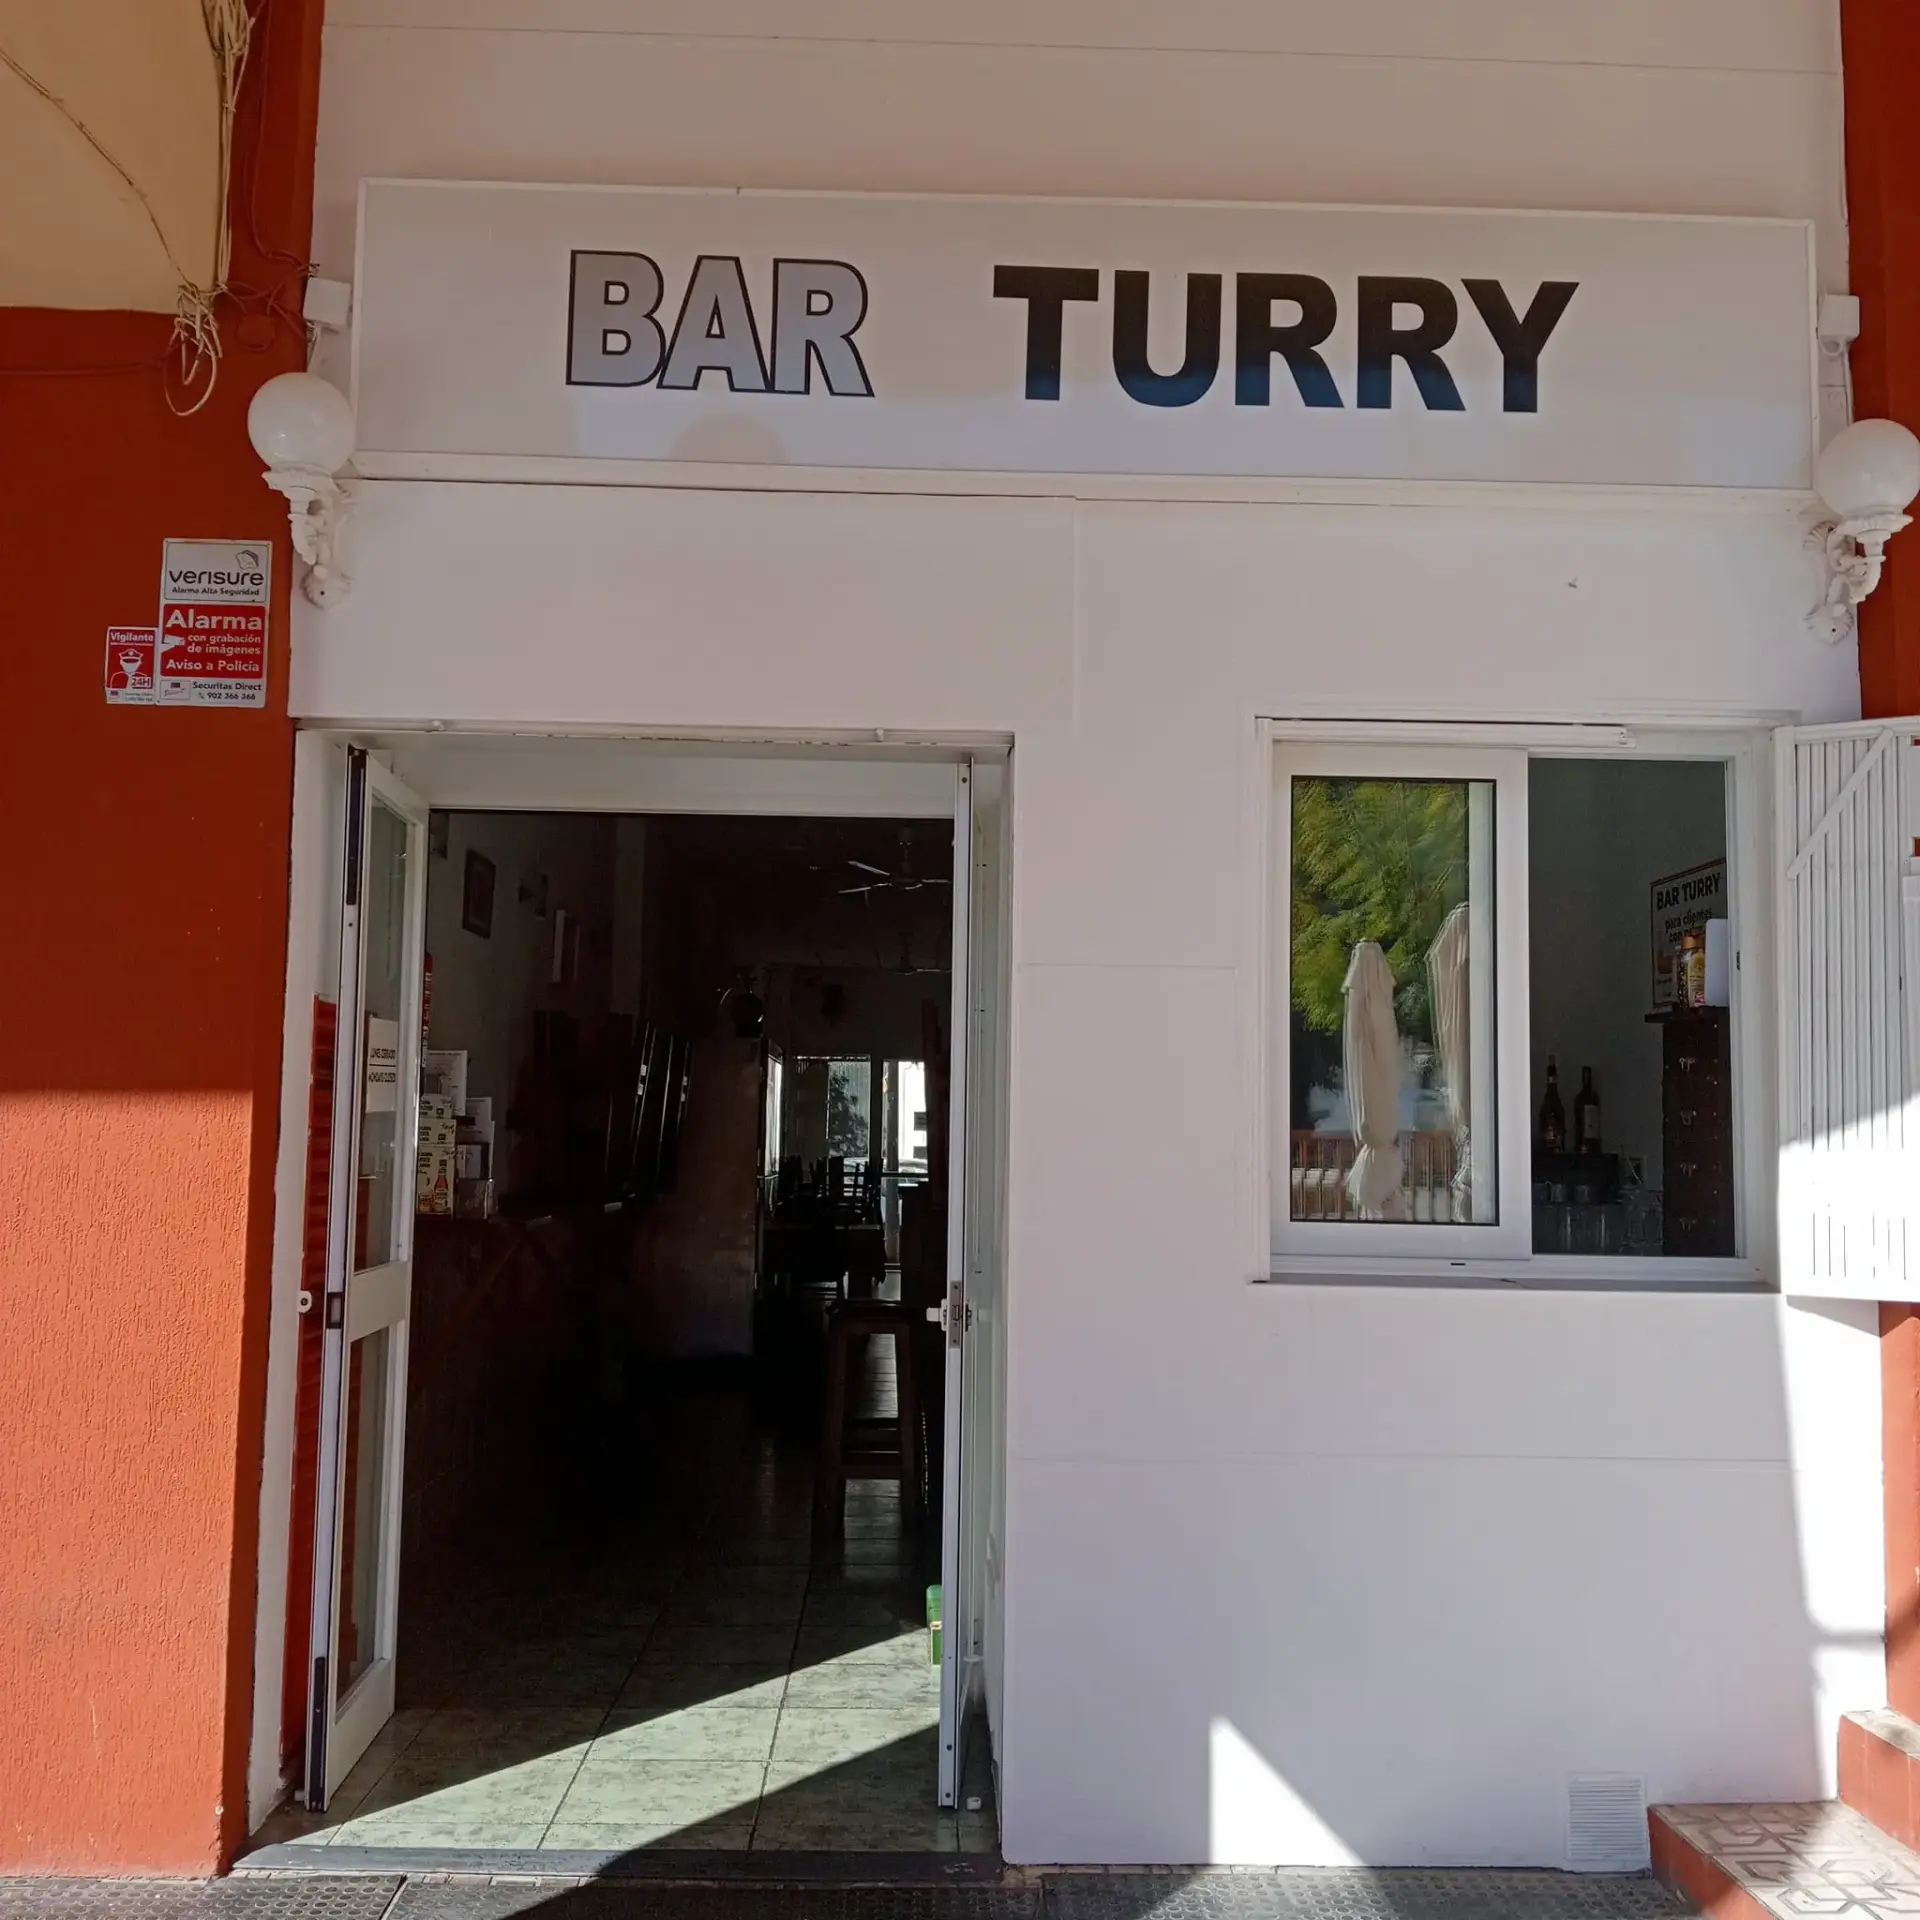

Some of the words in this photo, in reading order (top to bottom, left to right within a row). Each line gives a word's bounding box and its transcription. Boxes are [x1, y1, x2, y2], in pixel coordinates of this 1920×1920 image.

[566, 250, 875, 397] BAR
[993, 265, 1580, 414] TURRY
[169, 570, 264, 586] verisure
[172, 587, 199, 595] Alarma
[220, 588, 260, 597] Seguridad
[165, 609, 263, 630] Alarma
[110, 631, 154, 643] Vigilante
[188, 634, 206, 642] con
[209, 633, 261, 645] grabación
[187, 644, 202, 653] de
[205, 643, 261, 656] imágenes
[166, 659, 203, 670] Aviso
[206, 662, 214, 671] a
[217, 658, 260, 672] Policía
[131, 676, 151, 687] 24H
[192, 681, 233, 690] Securitas
[235, 682, 262, 691] Direct
[207, 692, 222, 700] 902
[1656, 887, 1681, 910] BAR
[1682, 872, 1721, 902] TURRY
